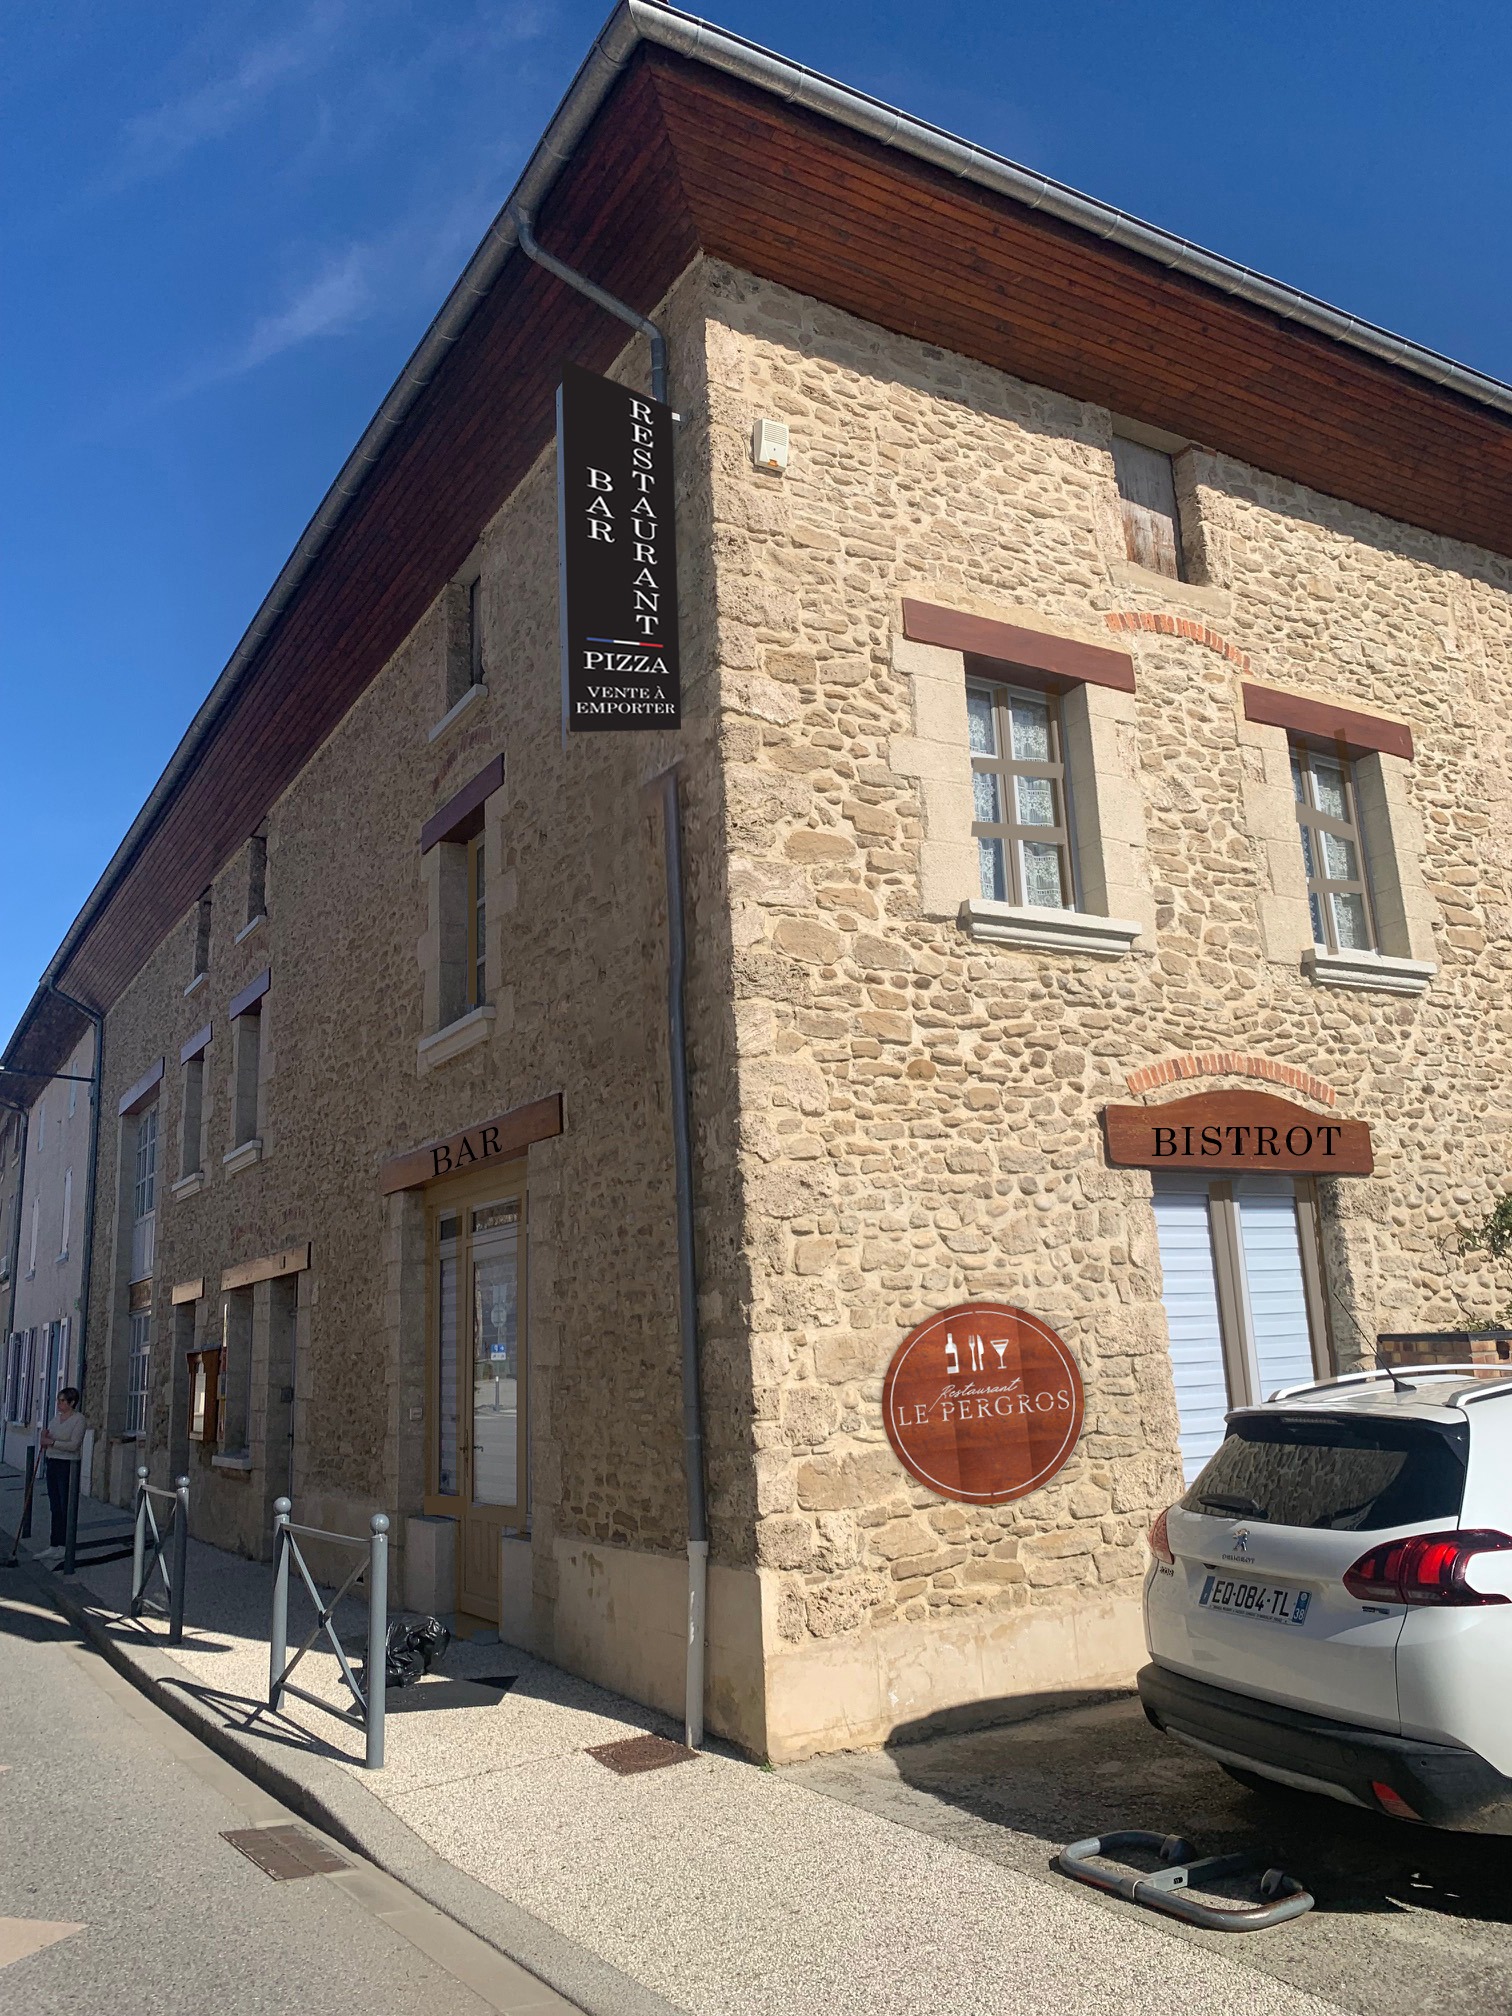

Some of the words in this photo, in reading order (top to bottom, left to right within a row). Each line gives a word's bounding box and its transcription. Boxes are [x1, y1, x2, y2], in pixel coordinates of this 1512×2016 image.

[586, 466, 616, 543] BAR
[629, 397, 660, 636] RESTAURANT
[583, 651, 670, 674] PIZZA
[576, 702, 676, 715] EMPORTER
[587, 686, 650, 700] VENTE
[653, 684, 666, 700] À
[430, 1126, 503, 1178] BAR
[1152, 1126, 1342, 1157] BISTROT
[898, 1404, 930, 1426] LE
[940, 1389, 1071, 1422] PERGROS
[929, 1377, 1022, 1413] Restaurant
[1293, 1608, 1304, 1620] 38
